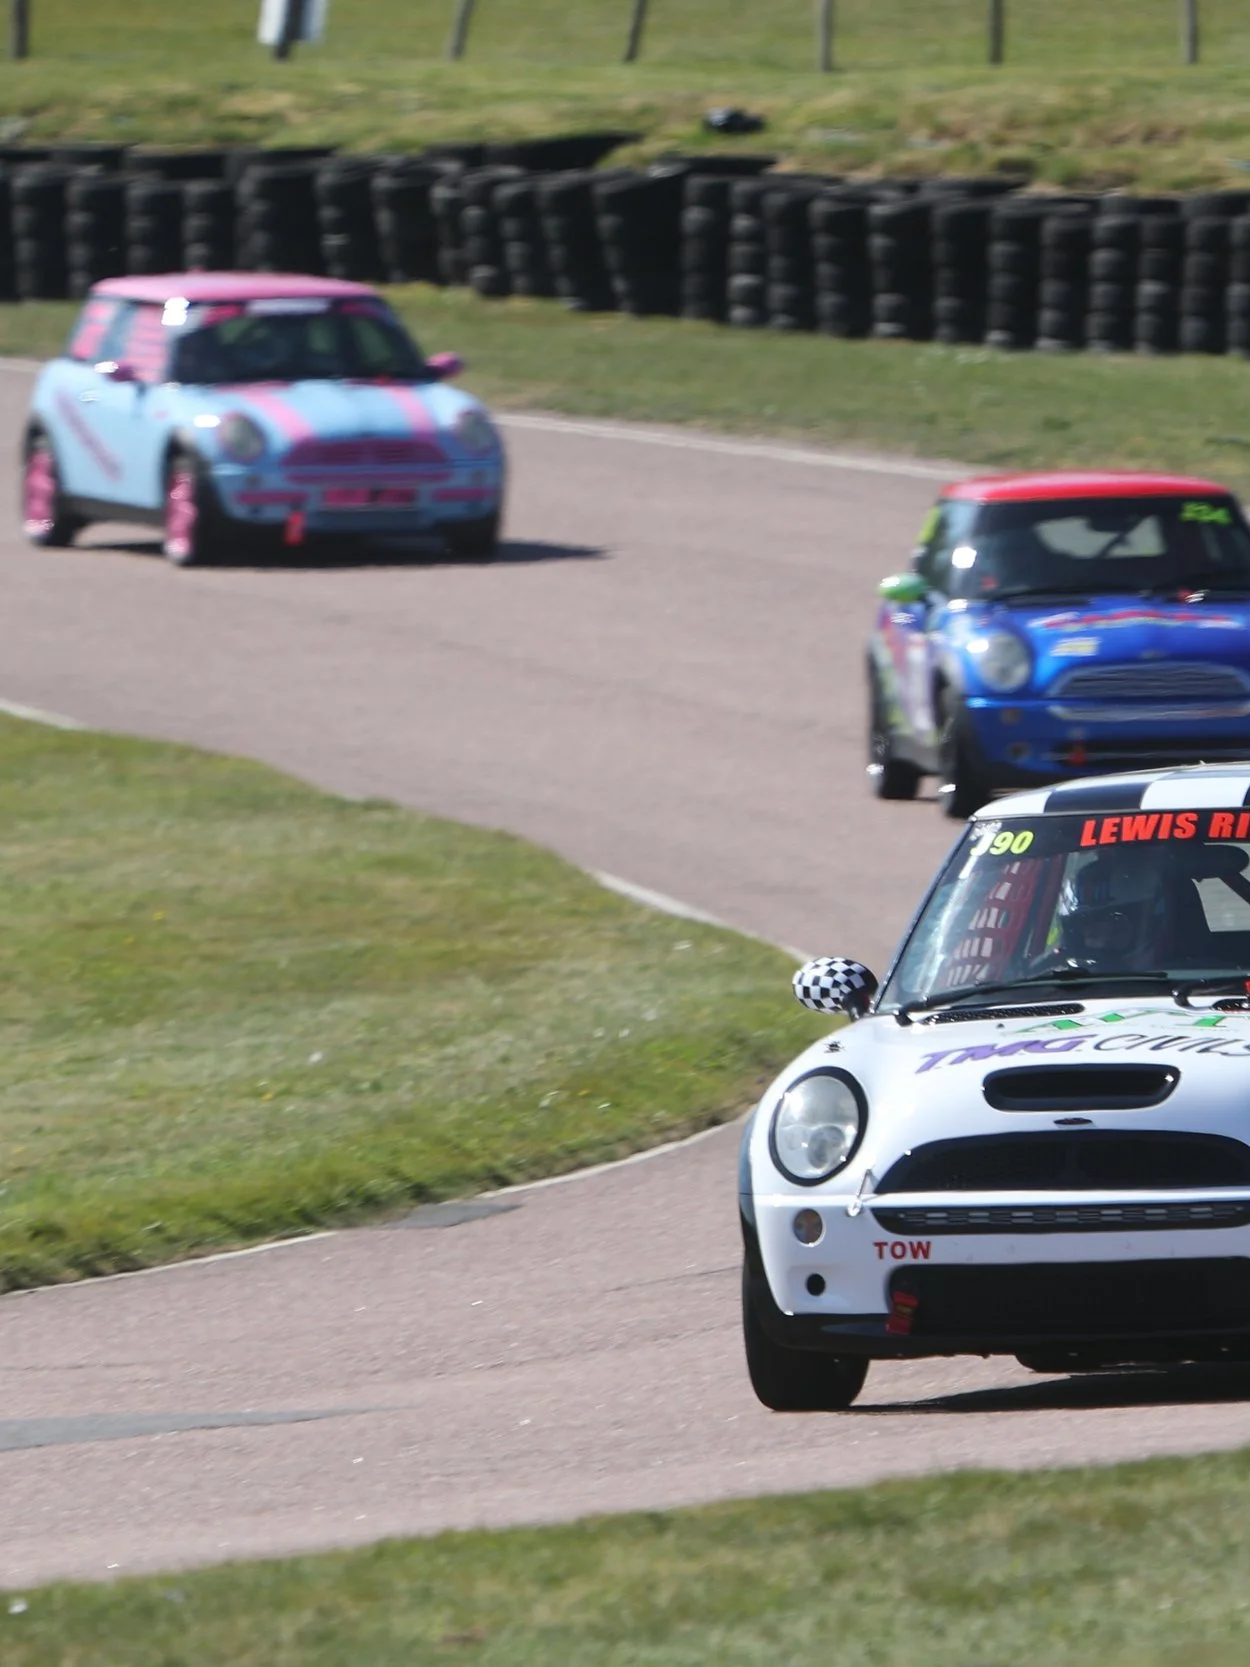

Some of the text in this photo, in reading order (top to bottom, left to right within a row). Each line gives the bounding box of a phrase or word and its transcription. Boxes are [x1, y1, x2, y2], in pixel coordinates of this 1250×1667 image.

[970, 830, 1034, 856] J90
[1080, 813, 1198, 847] LEWIS
[873, 1241, 932, 1260] TOW
